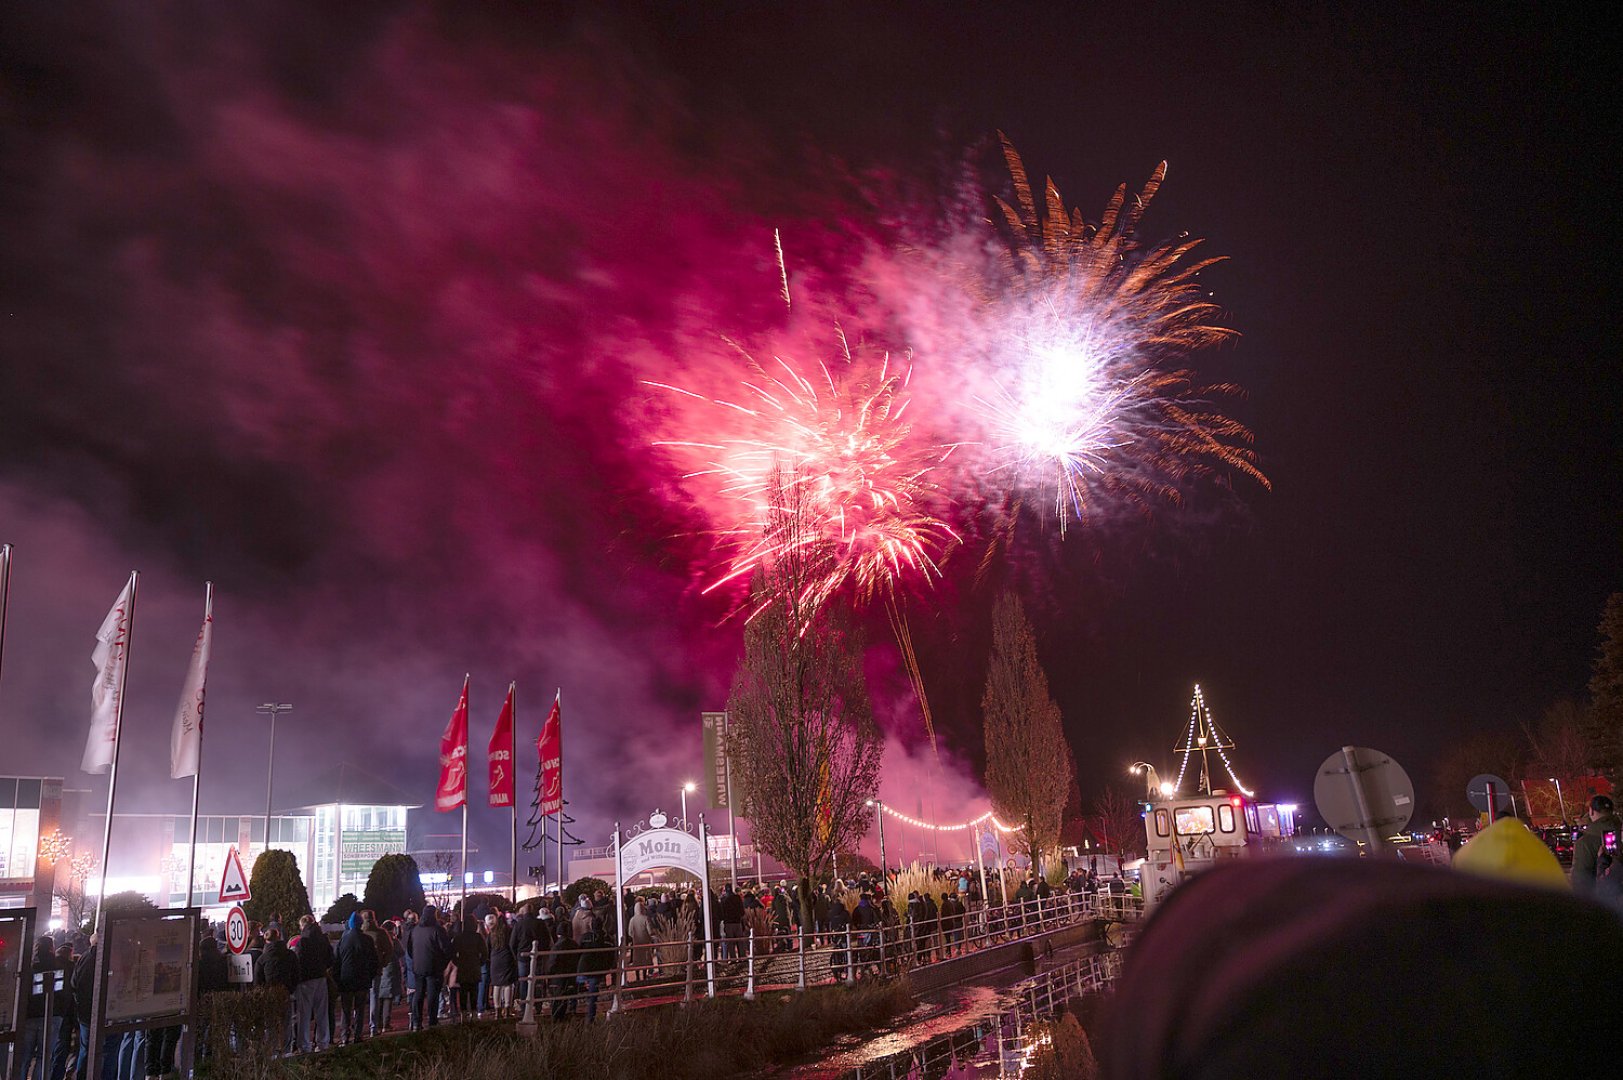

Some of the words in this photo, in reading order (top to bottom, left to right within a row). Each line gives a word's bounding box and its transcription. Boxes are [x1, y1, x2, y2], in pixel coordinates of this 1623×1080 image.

[344, 843, 404, 853] WREESMANN
[639, 838, 681, 857] Moin
[231, 920, 243, 941] 30
